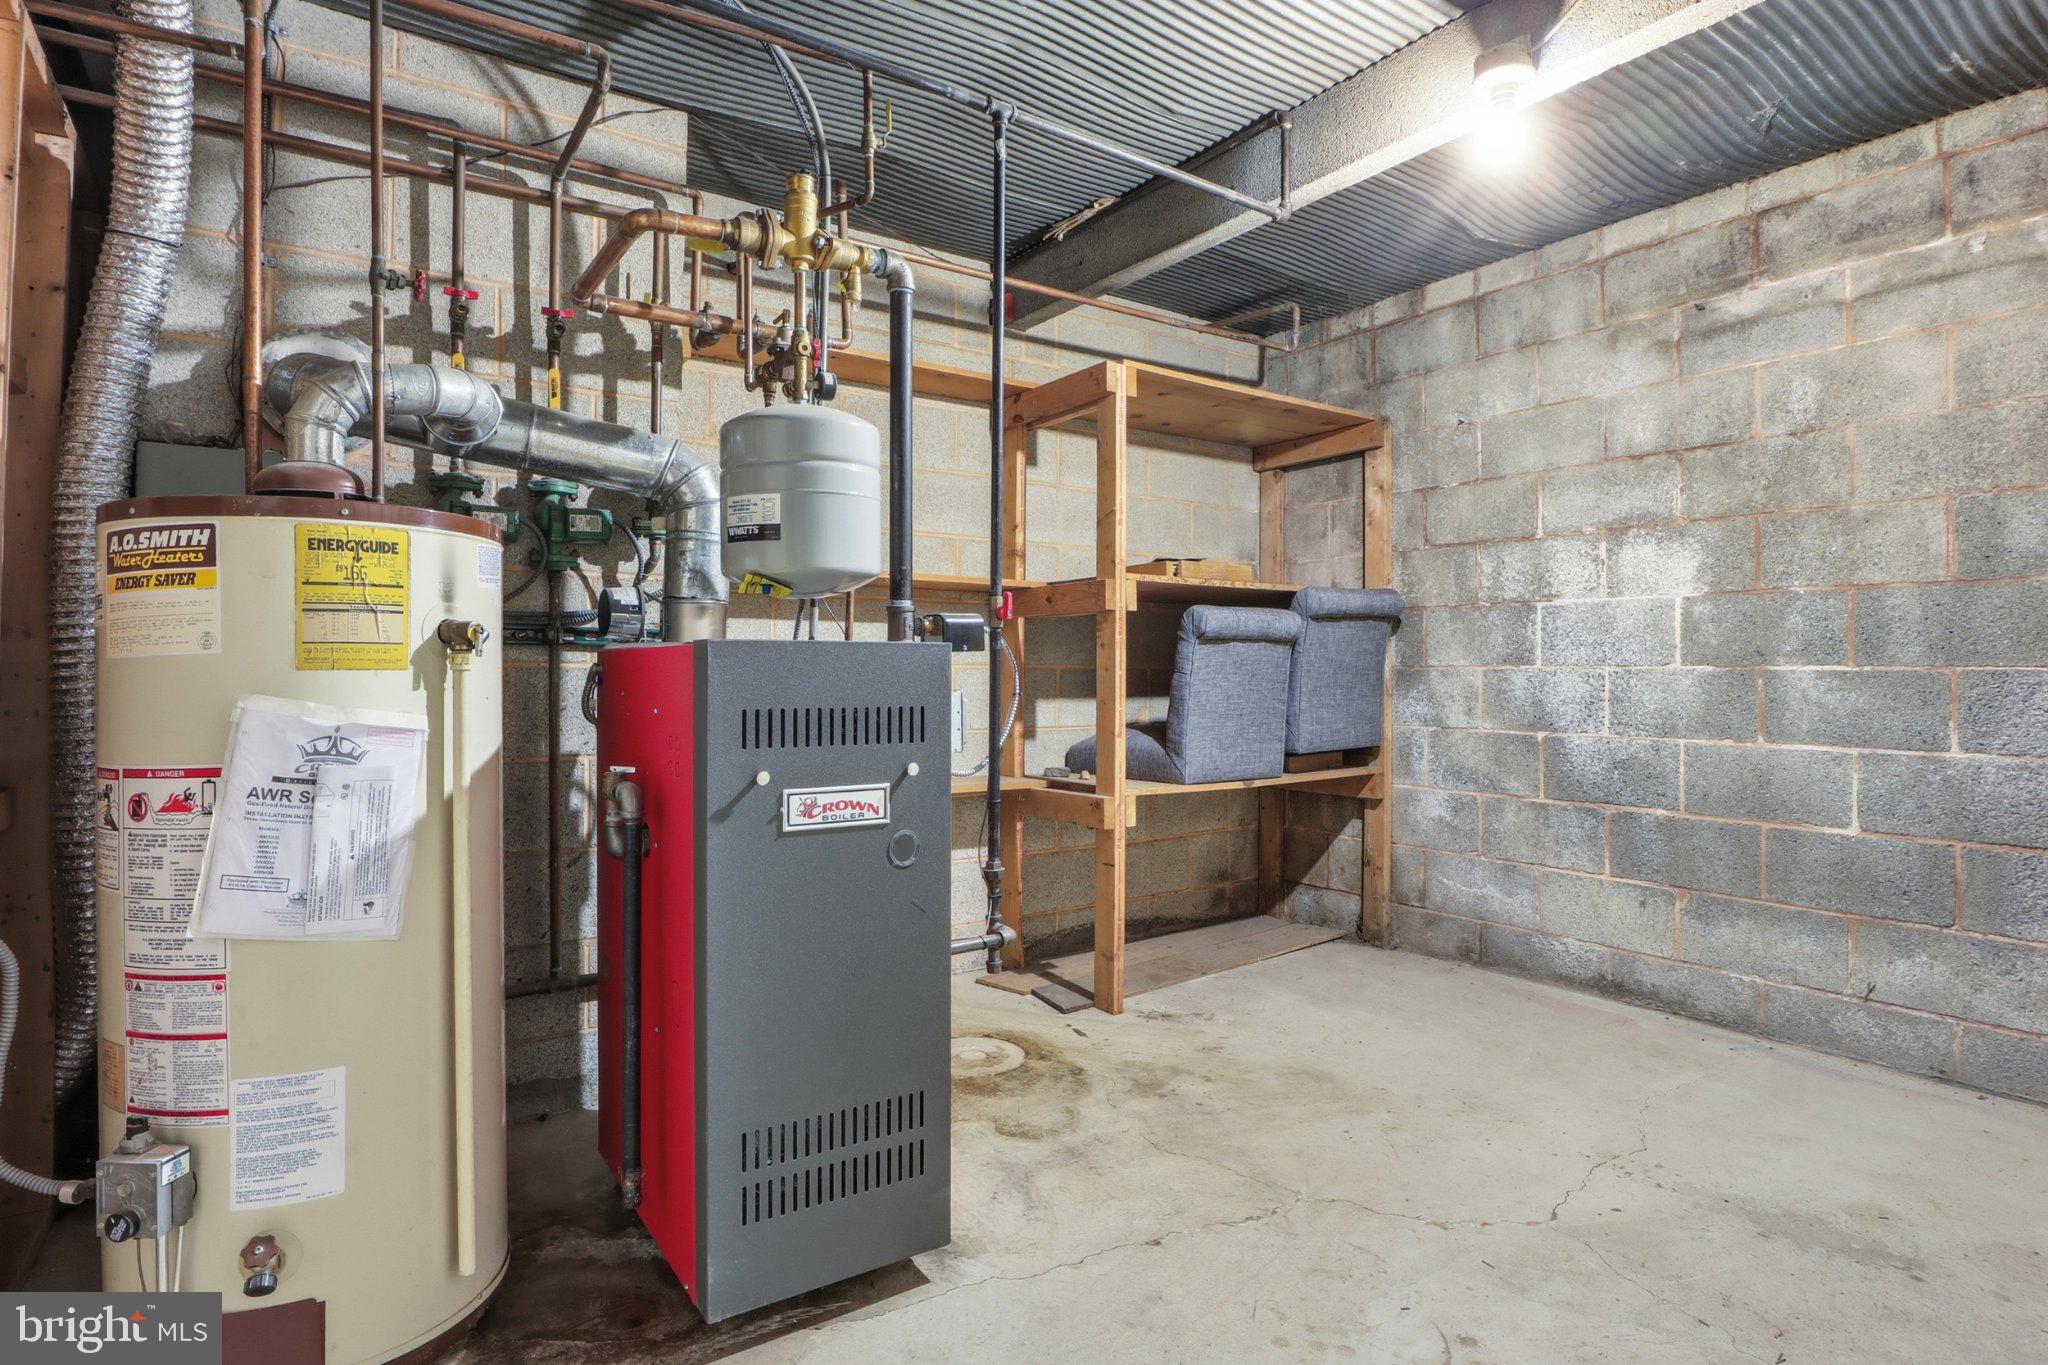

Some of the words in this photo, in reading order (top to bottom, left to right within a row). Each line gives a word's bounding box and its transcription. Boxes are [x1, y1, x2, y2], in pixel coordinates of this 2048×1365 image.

[110, 552, 142, 567] Water
[141, 550, 204, 568] Heaters
[114, 574, 153, 591] ENERGY
[154, 572, 196, 587] SAVER
[246, 786, 292, 803] AWR
[298, 790, 315, 804] S
[806, 800, 880, 819] CROWN
[821, 812, 865, 821] BOILER
